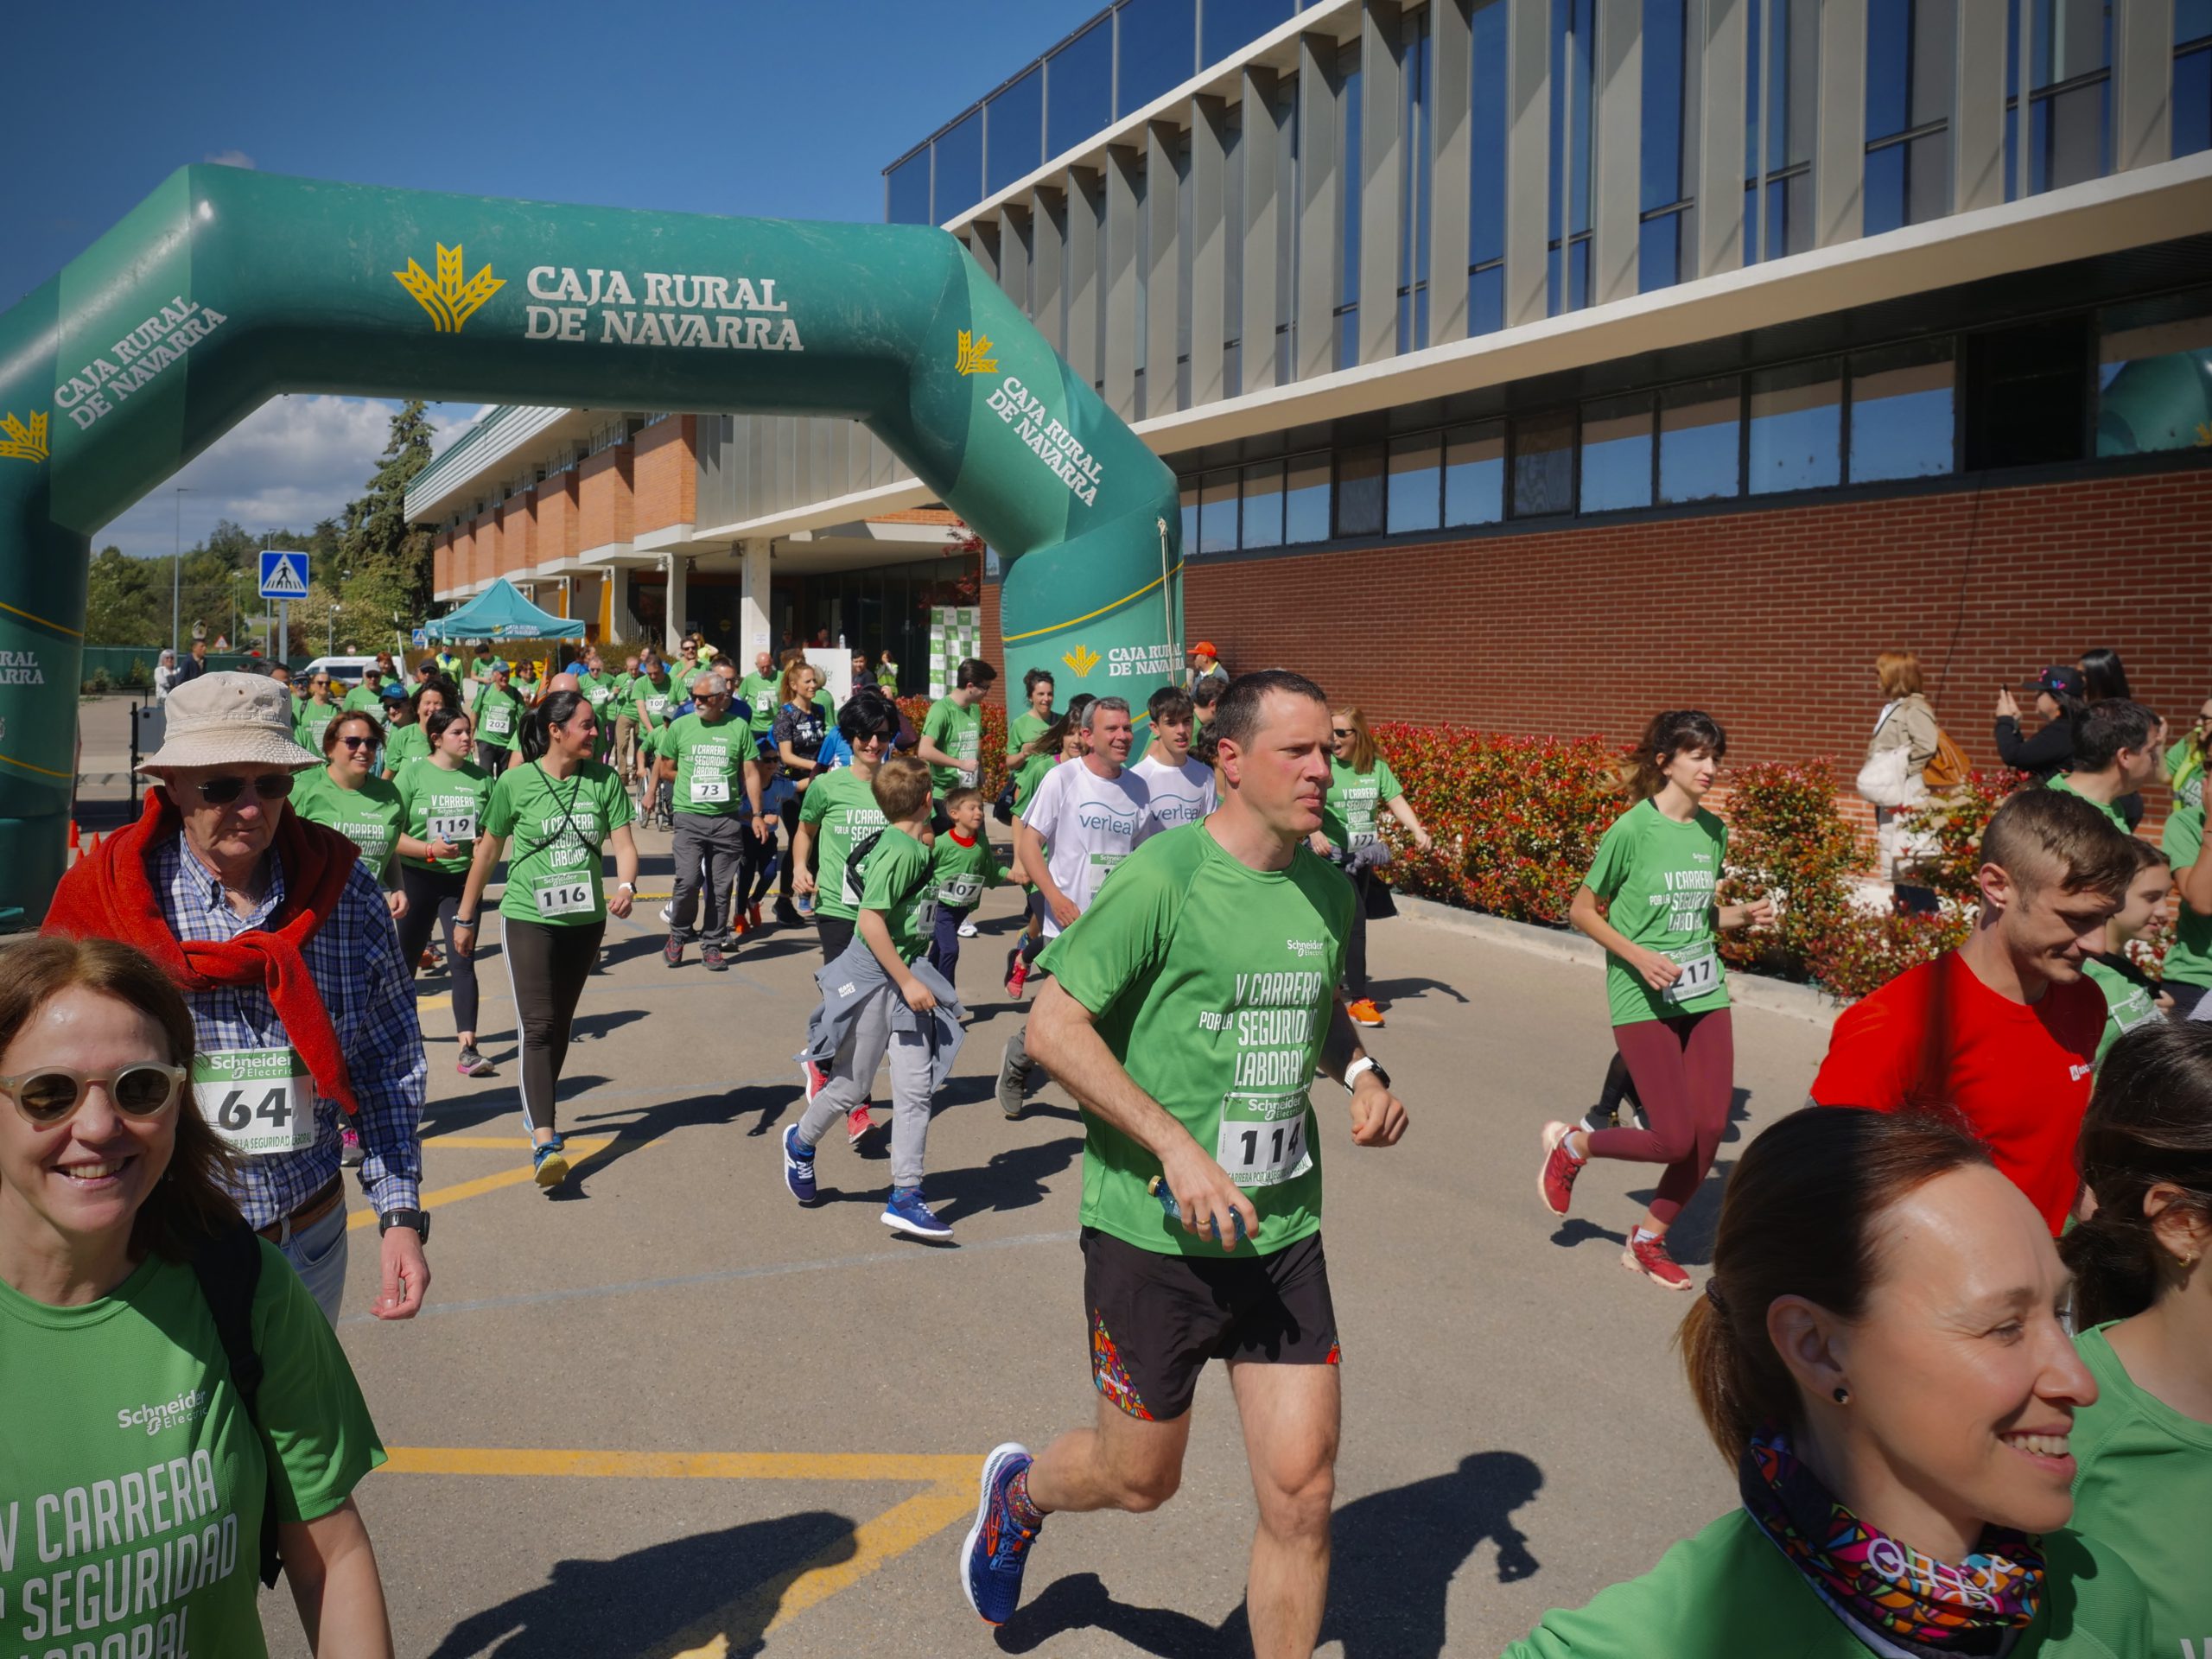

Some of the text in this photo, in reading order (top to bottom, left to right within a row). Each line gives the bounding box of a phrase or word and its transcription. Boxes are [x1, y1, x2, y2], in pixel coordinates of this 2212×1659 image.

[526, 265, 787, 313] CAJA RURAL
[524, 306, 804, 352] DE NAVARRA
[54, 296, 200, 409] CAJA RURAL
[69, 308, 228, 430] DE NAVARRA
[1003, 376, 1103, 485] CAJA RURAL
[986, 389, 1097, 507] DE NAVARRA
[1109, 647, 1147, 662] CAJA
[1109, 658, 1185, 677] DE NAVARA
[692, 745, 726, 755] V CARRERA
[701, 785, 719, 796] 73
[432, 795, 474, 808] V CARRERA
[435, 818, 470, 834] 119
[846, 809, 853, 824] V
[948, 882, 977, 897] 107
[1664, 872, 1673, 891] V
[543, 887, 586, 907] 116
[1287, 939, 1324, 951] Schneider
[1234, 971, 1322, 1007] V CARRERA
[1198, 1011, 1222, 1032] POR
[1222, 1013, 1233, 1030] LA
[211, 1053, 293, 1070] Schneider
[247, 1066, 293, 1077] Electric
[218, 1088, 292, 1131] 64
[1248, 1096, 1301, 1112] Schneider
[251, 1135, 290, 1149] SEGURIDAD
[1240, 1121, 1301, 1166] 114
[118, 1389, 206, 1428] Schneider
[164, 1406, 208, 1429] Electric
[35, 1448, 218, 1563] CARRERA
[22, 1513, 238, 1642] SEGURIDAD
